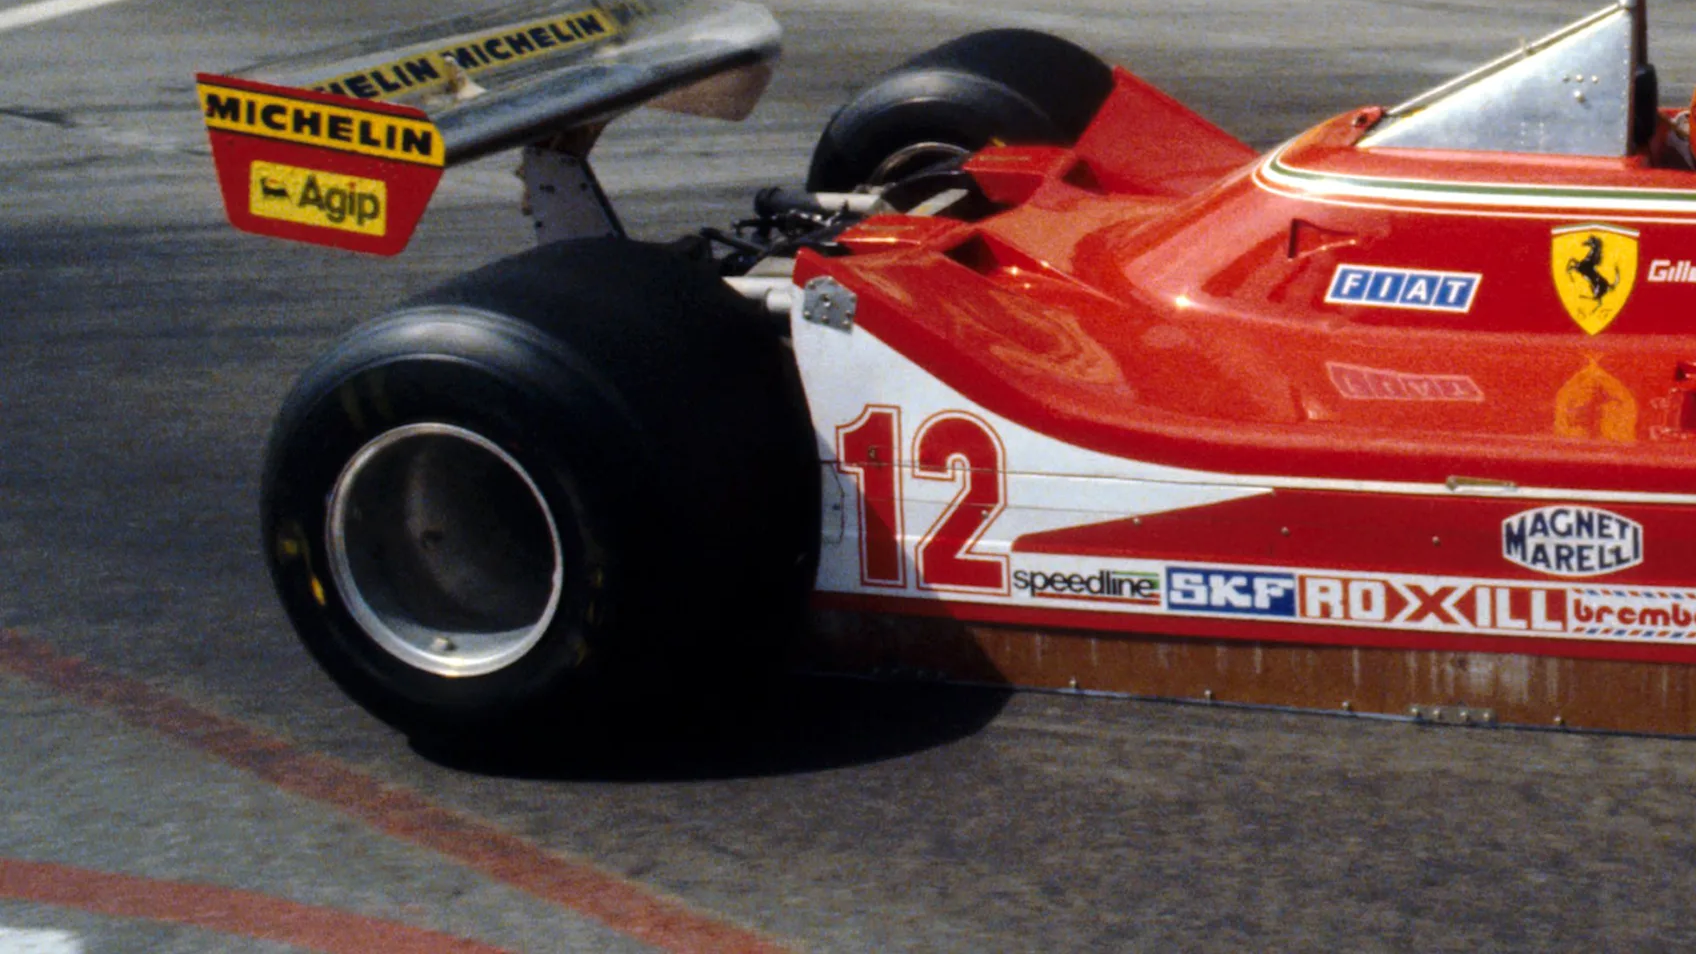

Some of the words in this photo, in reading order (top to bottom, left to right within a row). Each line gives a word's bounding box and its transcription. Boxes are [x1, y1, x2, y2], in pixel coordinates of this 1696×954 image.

[439, 13, 606, 72] MICHELIN
[205, 94, 434, 157] MICHELIN
[300, 174, 382, 226] Agip
[1338, 270, 1470, 307] FIAT
[835, 403, 1011, 596] 12
[1013, 568, 1156, 599] speedline
[1169, 572, 1294, 610] SKF
